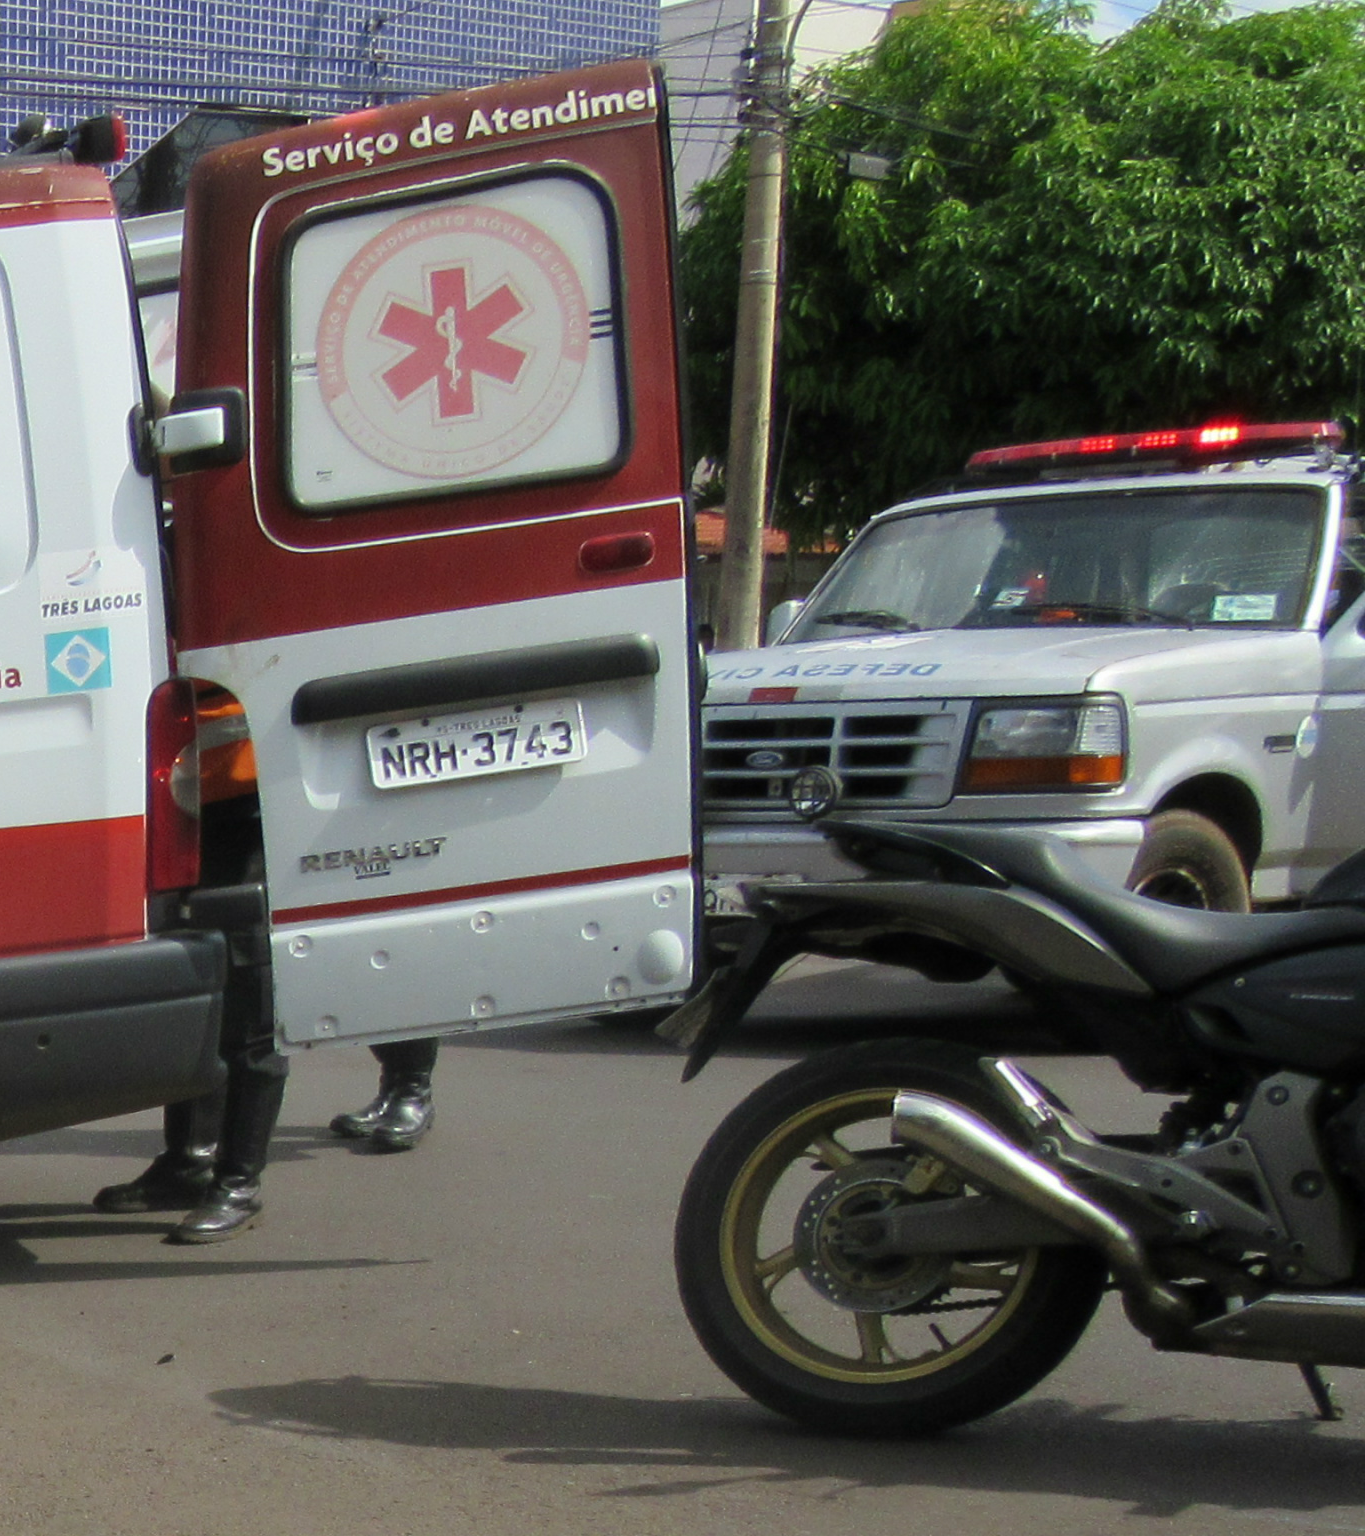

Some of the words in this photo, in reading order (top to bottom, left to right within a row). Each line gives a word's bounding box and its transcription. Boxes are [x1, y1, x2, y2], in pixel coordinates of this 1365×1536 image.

[262, 131, 399, 176] Serviço
[410, 116, 455, 148] de
[84, 593, 142, 613] LAGOAS
[299, 837, 446, 873] RENAULT
